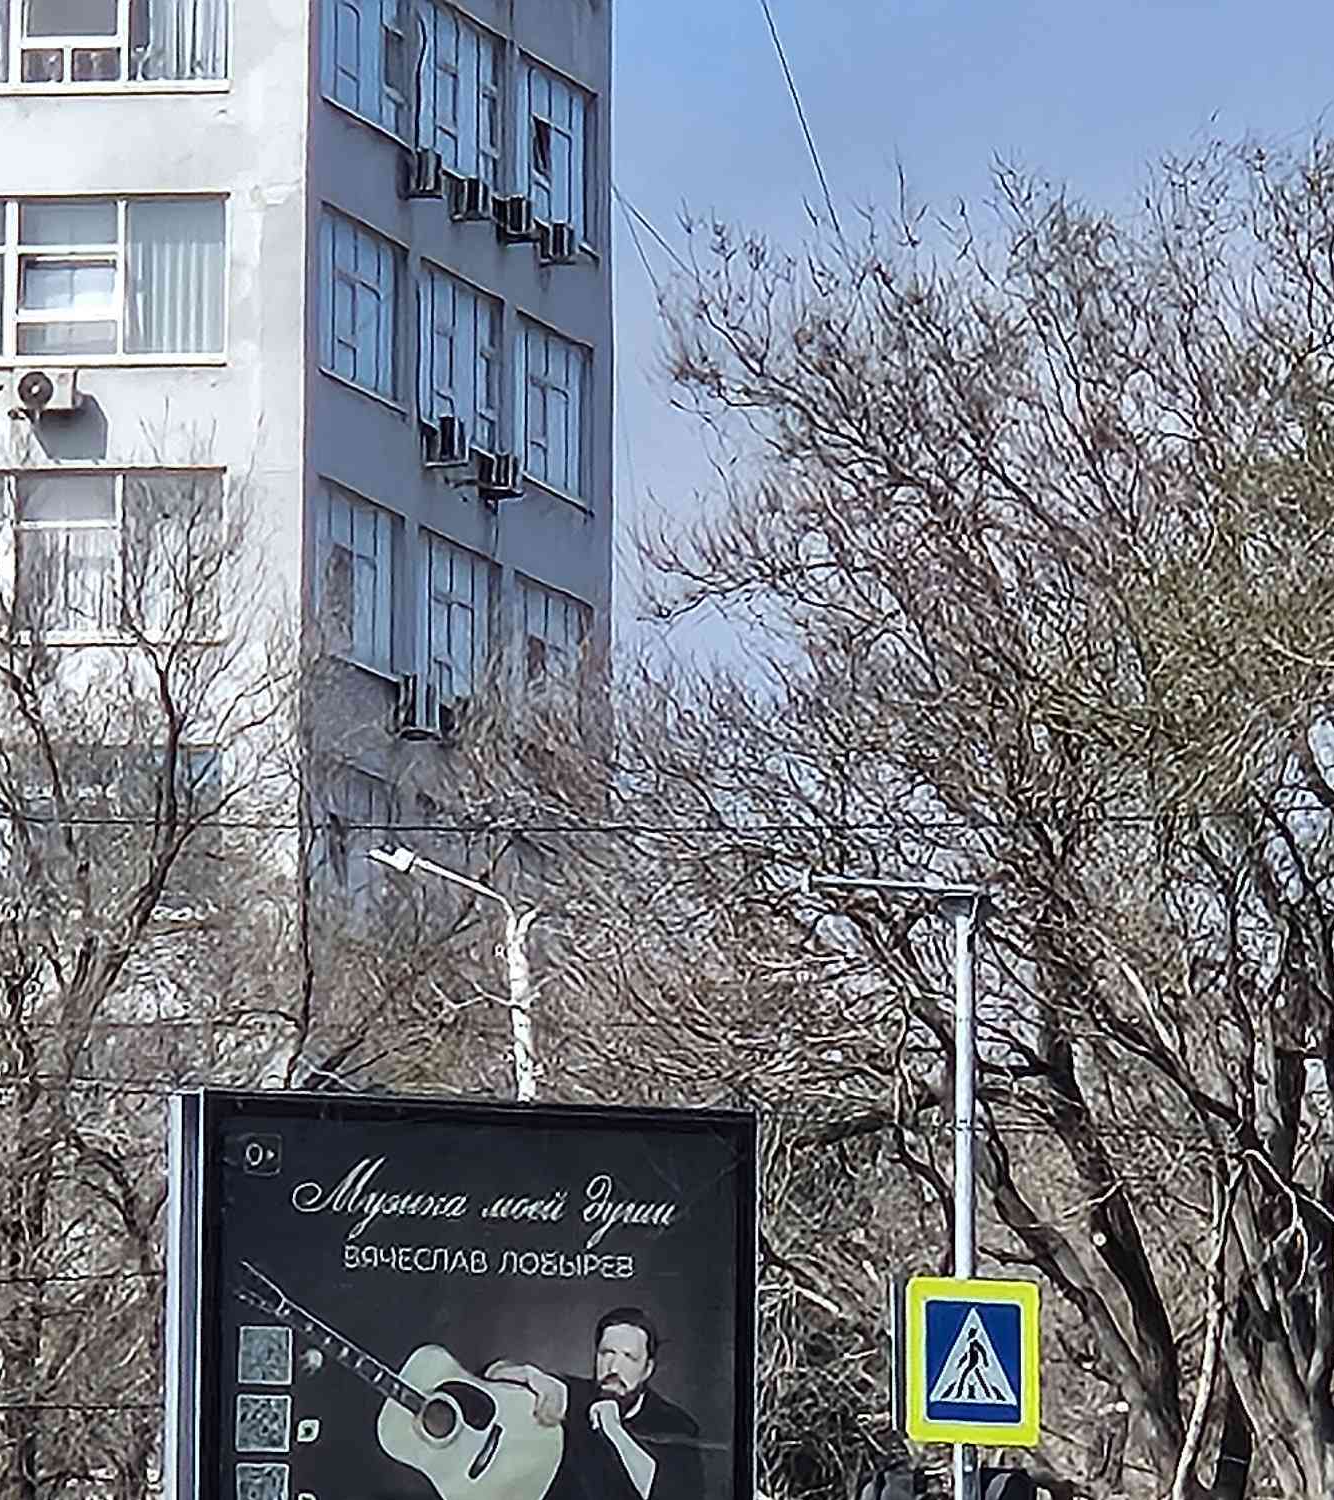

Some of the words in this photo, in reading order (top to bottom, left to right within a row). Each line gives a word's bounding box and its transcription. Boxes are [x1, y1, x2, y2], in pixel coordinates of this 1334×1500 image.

[292, 1154, 468, 1240] Музыка
[481, 1191, 568, 1222] моей
[343, 1244, 487, 1274] ВЯЧЕСЛАВ
[498, 1250, 636, 1279] ЛОБЫРЕВ
